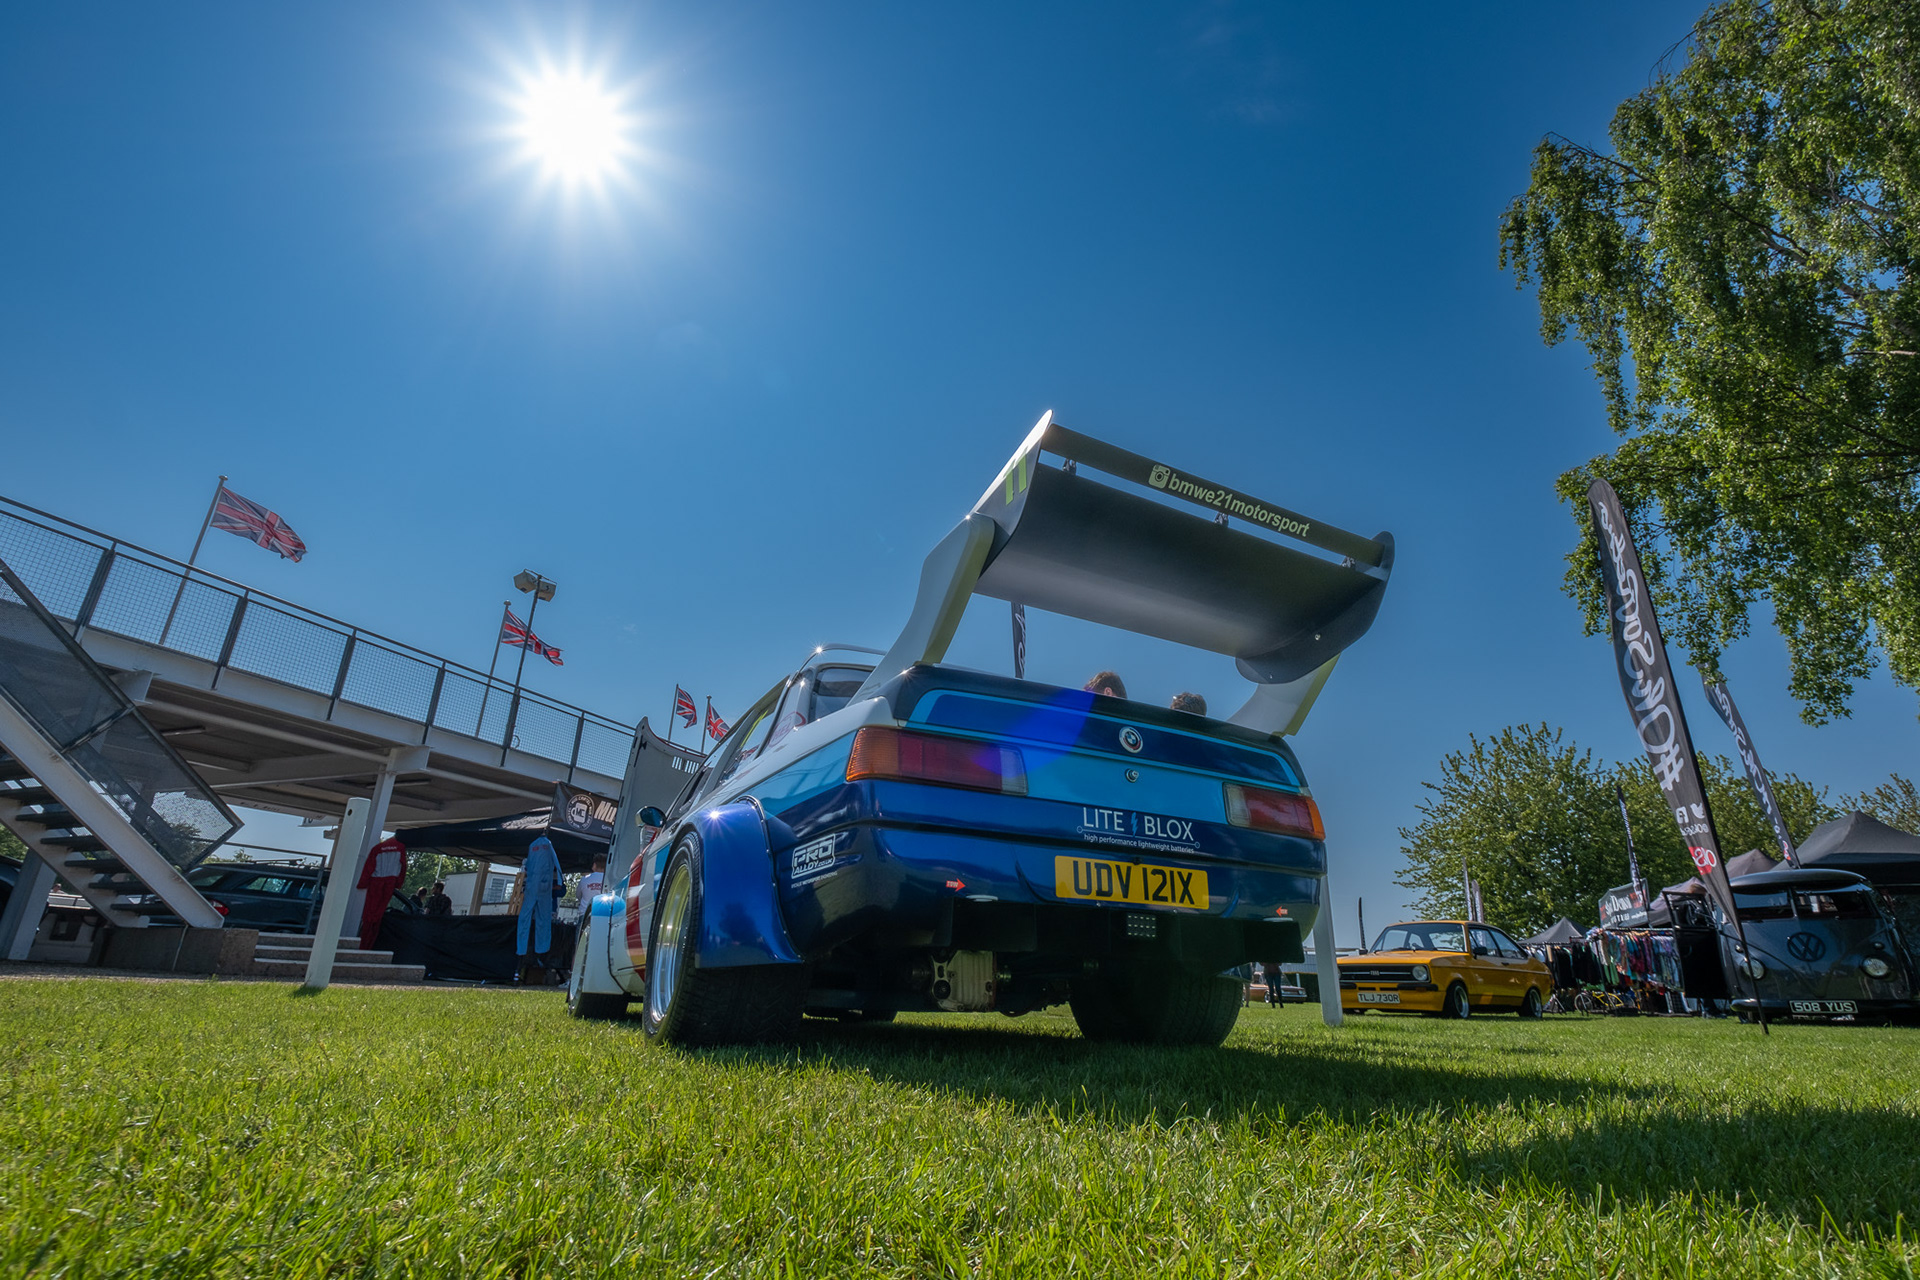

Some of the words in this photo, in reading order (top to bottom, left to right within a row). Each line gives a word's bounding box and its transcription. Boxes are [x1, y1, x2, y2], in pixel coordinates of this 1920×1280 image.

[1168, 473, 1310, 537] bmwe21motorsport
[1083, 807, 1125, 831] LITE
[1144, 815, 1194, 841] BLOX
[795, 839, 833, 867] PRO
[1084, 833, 1098, 843] high
[1099, 836, 1137, 847] performance
[1138, 840, 1170, 852] lightweight
[1171, 844, 1195, 854] batteries
[1073, 860, 1131, 899] UDV
[1142, 867, 1195, 905] 121X
[1358, 993, 1375, 1002] TLJ
[1377, 993, 1399, 1003] 730R
[1794, 1002, 1820, 1012] 508
[1826, 1002, 1852, 1012] YUS
